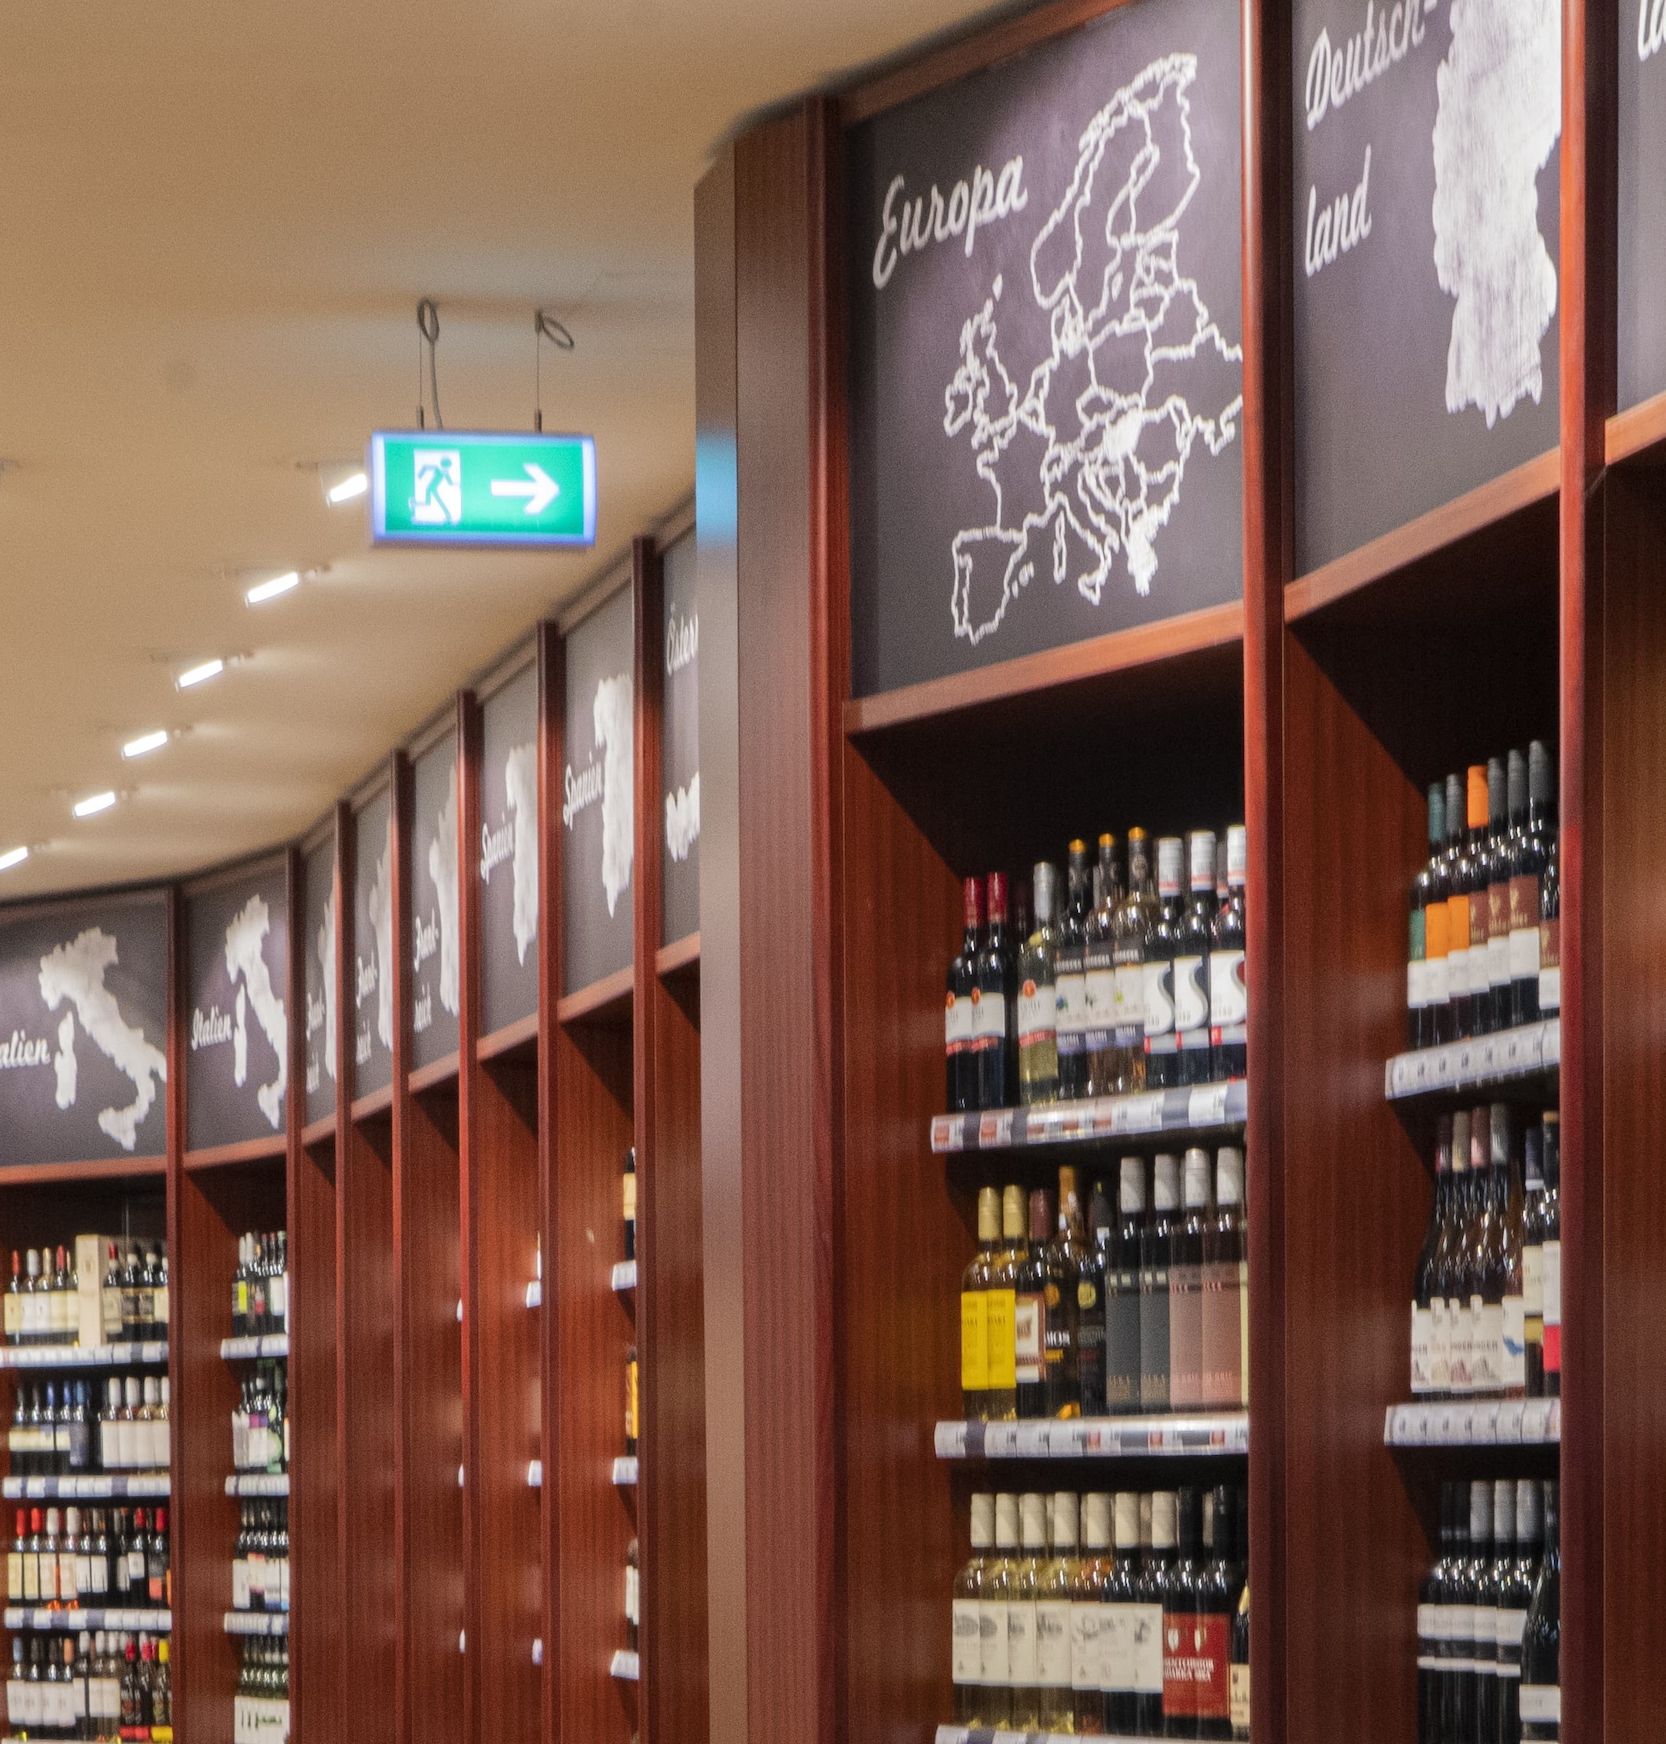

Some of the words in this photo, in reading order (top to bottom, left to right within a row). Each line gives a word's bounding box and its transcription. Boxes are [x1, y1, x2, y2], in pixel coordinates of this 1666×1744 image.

[873, 155, 1029, 290] Europa
[1305, 145, 1372, 277] land
[563, 751, 603, 831] Spanien
[190, 1006, 233, 1051] Italien
